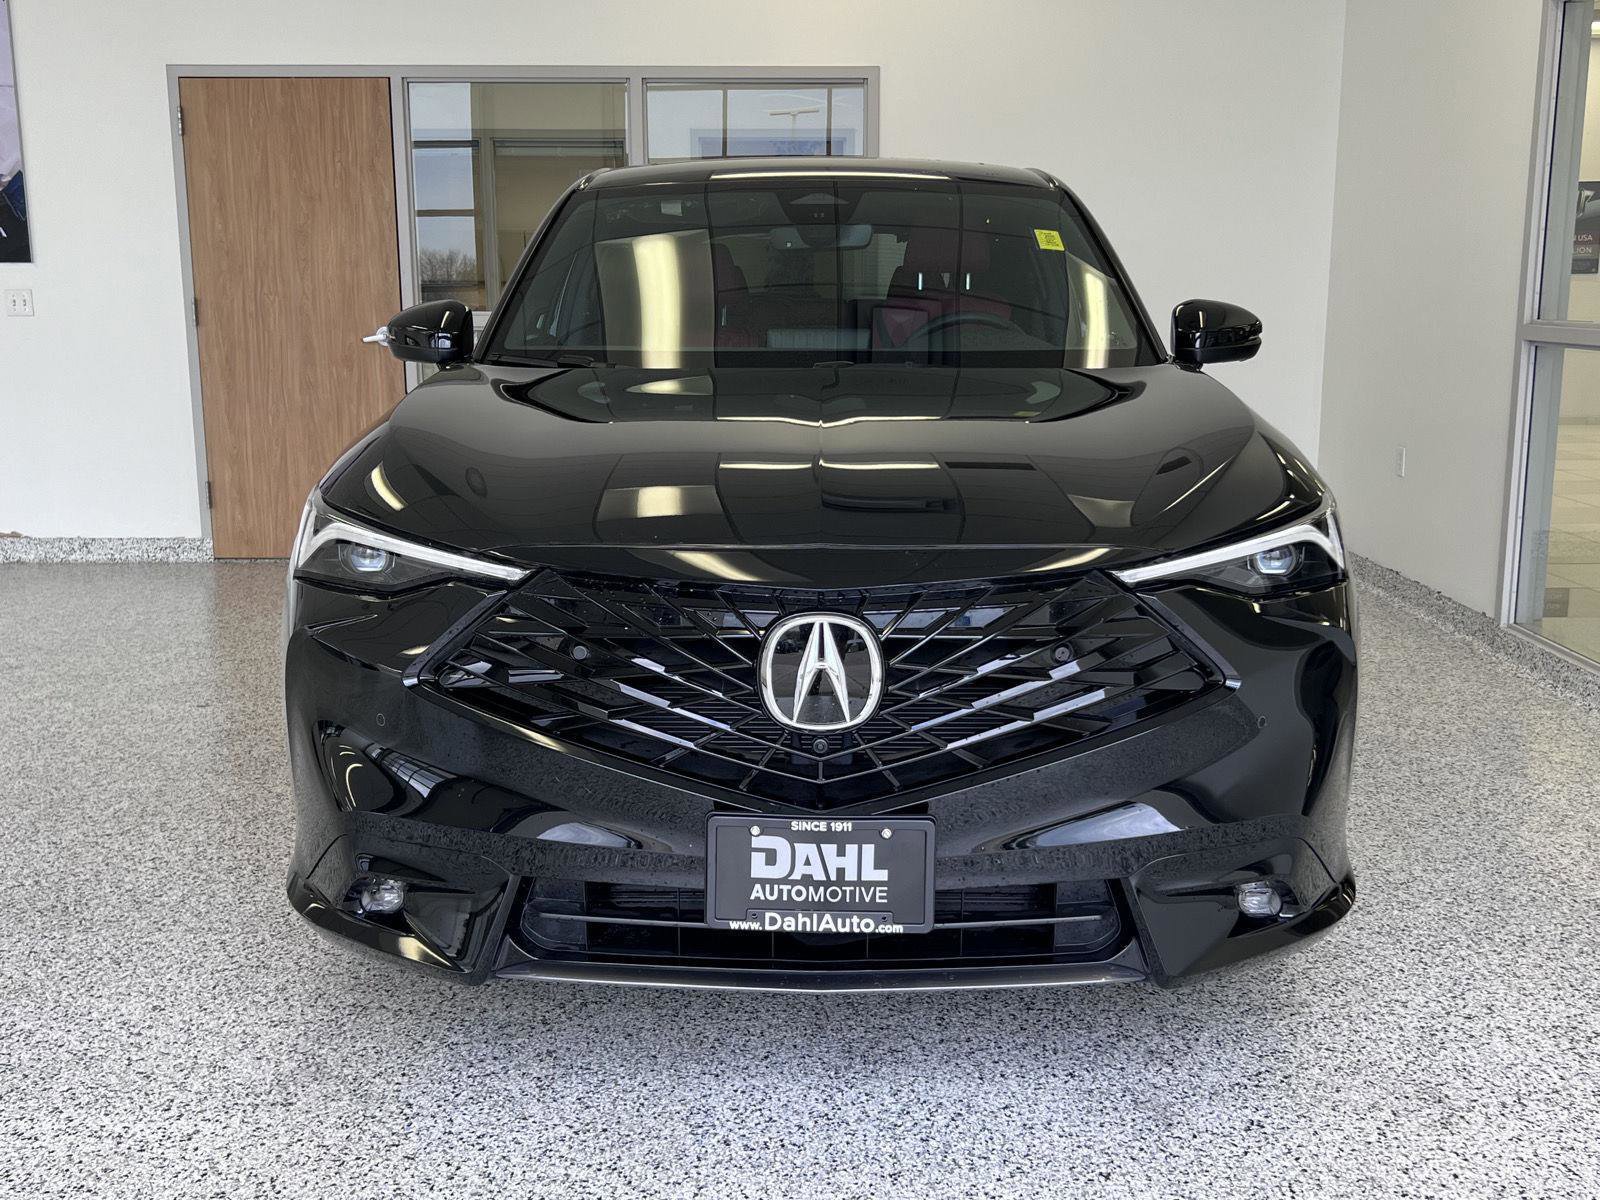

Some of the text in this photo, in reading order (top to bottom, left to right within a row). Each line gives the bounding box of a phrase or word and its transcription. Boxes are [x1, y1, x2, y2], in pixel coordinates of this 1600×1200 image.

[1577, 234, 1593, 242] USA
[790, 820, 853, 832] SINCE 1911
[750, 835, 889, 881] DAHL
[749, 883, 888, 903] AUTOMOTIVE
[729, 912, 904, 934] www.DahlAuto.com
